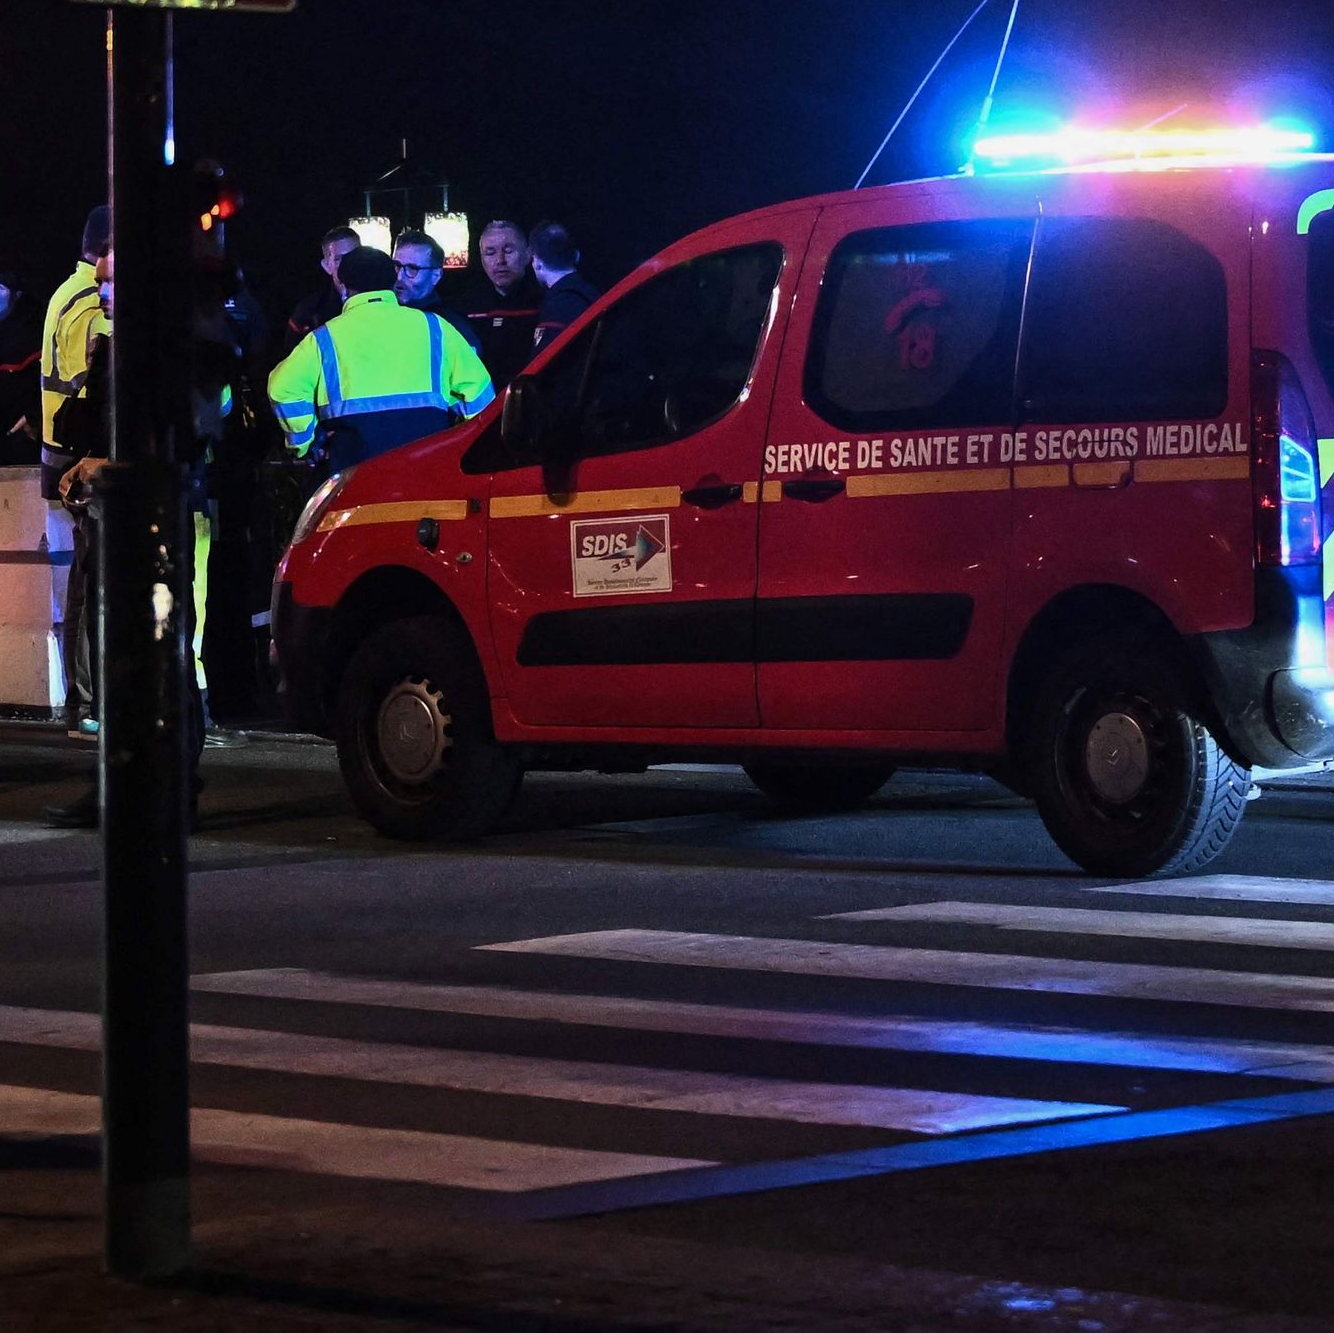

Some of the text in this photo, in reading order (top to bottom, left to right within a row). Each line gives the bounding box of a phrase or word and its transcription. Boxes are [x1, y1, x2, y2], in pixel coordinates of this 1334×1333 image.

[899, 322, 935, 369] 18
[764, 423, 1248, 474] SERVICE DE SANTE ET DE SECOURS MEDICAL
[581, 532, 628, 557] SDIS
[610, 557, 631, 573] 33
